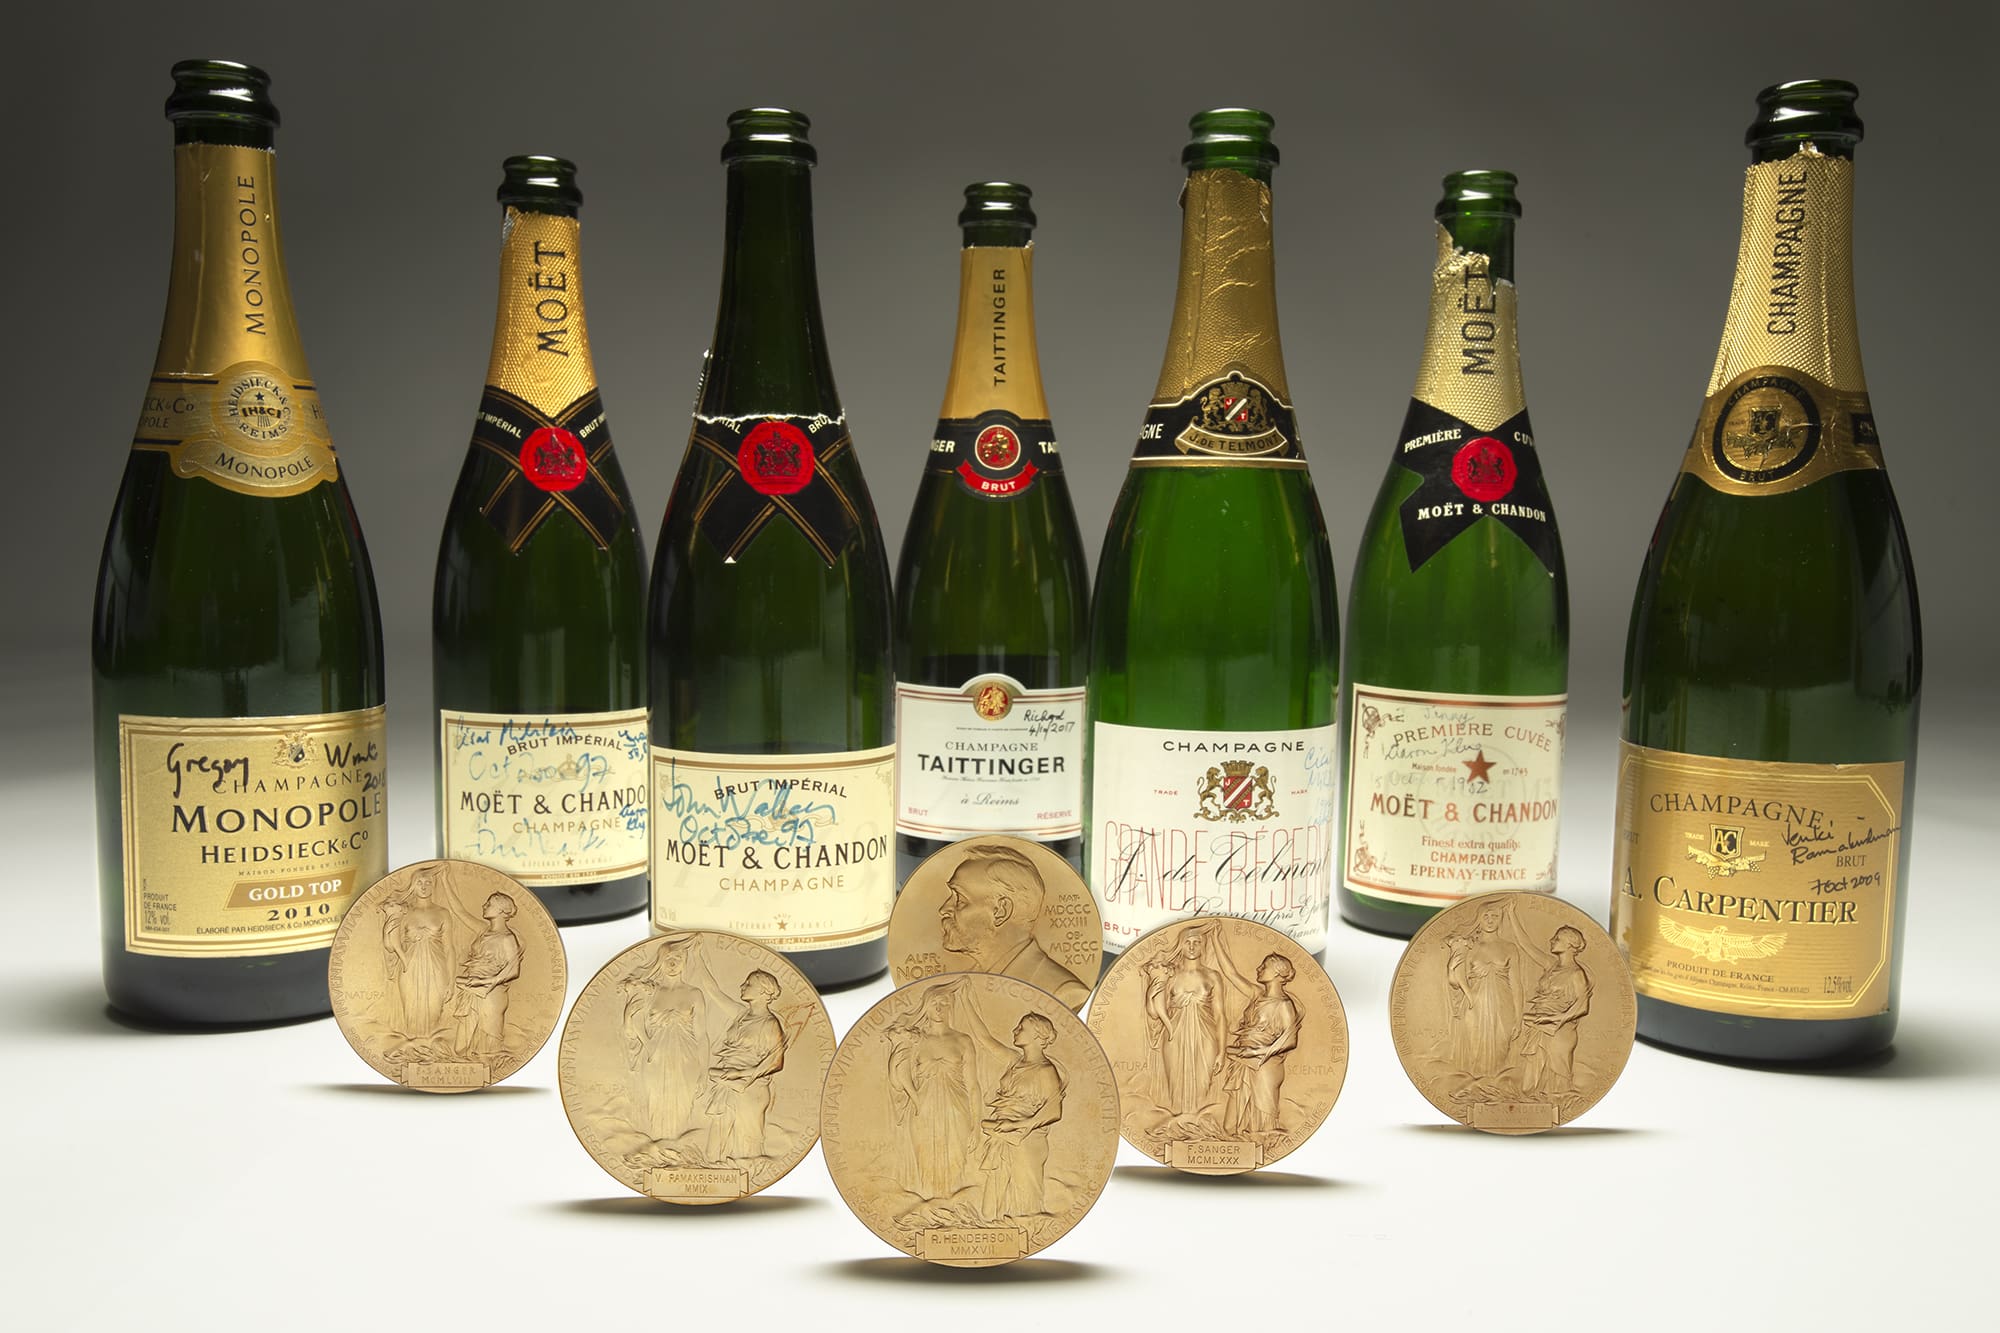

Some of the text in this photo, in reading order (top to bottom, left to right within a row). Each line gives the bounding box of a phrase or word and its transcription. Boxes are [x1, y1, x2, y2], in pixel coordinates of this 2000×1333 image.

[237, 175, 266, 335] MONOPOLE
[1766, 170, 1808, 336] CHAMPAGNE
[528, 240, 569, 357] MOËT
[993, 268, 1006, 387] TAITTINGER
[238, 421, 288, 439] REIMS
[579, 419, 599, 439] BRUT
[1404, 428, 1462, 453] PREMIÈRE
[215, 452, 314, 480] MONOPOLE
[981, 480, 1016, 491] BRUT
[1417, 502, 1547, 523] MOËT & CHANDON
[507, 736, 550, 755] BRUT
[556, 731, 622, 751] IMPÉRIAL
[945, 741, 1039, 752] CHAMPAGNE
[1163, 740, 1305, 753] CHAMPAGNE
[1504, 726, 1552, 752] CUVÉE
[917, 753, 1065, 775] TAITTINGER
[212, 768, 363, 794] CHAMPAGNE
[714, 778, 848, 801] BRUT IMPÉRIAL
[460, 785, 646, 814] MOËT & CHANDO
[972, 791, 1020, 806] Reims
[171, 792, 381, 834] MONOPOLE
[908, 806, 928, 817] BRUT
[1370, 793, 1558, 823] MOËT & CHANDON
[1650, 793, 1823, 829] CHAMPAGNE
[513, 817, 621, 834] CHAMPAGNE
[1422, 835, 1454, 848] Finest
[1458, 840, 1485, 849] extra
[666, 835, 888, 870] MOËT & CHANDON
[1430, 851, 1512, 865] CHAMPAGNE
[1836, 855, 1867, 867] BRUT
[1104, 820, 1209, 913] GRANDE
[249, 879, 342, 901] GOLD TOP
[719, 875, 845, 892] CHAMPAGNE
[1622, 866, 1858, 925] A. CARPENTIER
[266, 903, 330, 921] 2010
[1045, 904, 1091, 916] MDCCC
[1050, 916, 1088, 928] XXXIII
[1104, 921, 1142, 938] BRUT
[1050, 940, 1098, 953] MDCCC
[1065, 953, 1095, 965] XCVI
[1667, 960, 1709, 975] PRODUIT
[1712, 968, 1727, 978] DE
[1730, 971, 1775, 983] FRANCE
[1113, 1062, 1149, 1072] ATURA
[1187, 1156, 1240, 1165] MCMLXXX
[669, 1173, 737, 1184] RAMAKRISHNAN
[684, 1184, 708, 1194] MMIX
[944, 1233, 1013, 1243] HENDERSON
[950, 1246, 996, 1255] MMXVII
